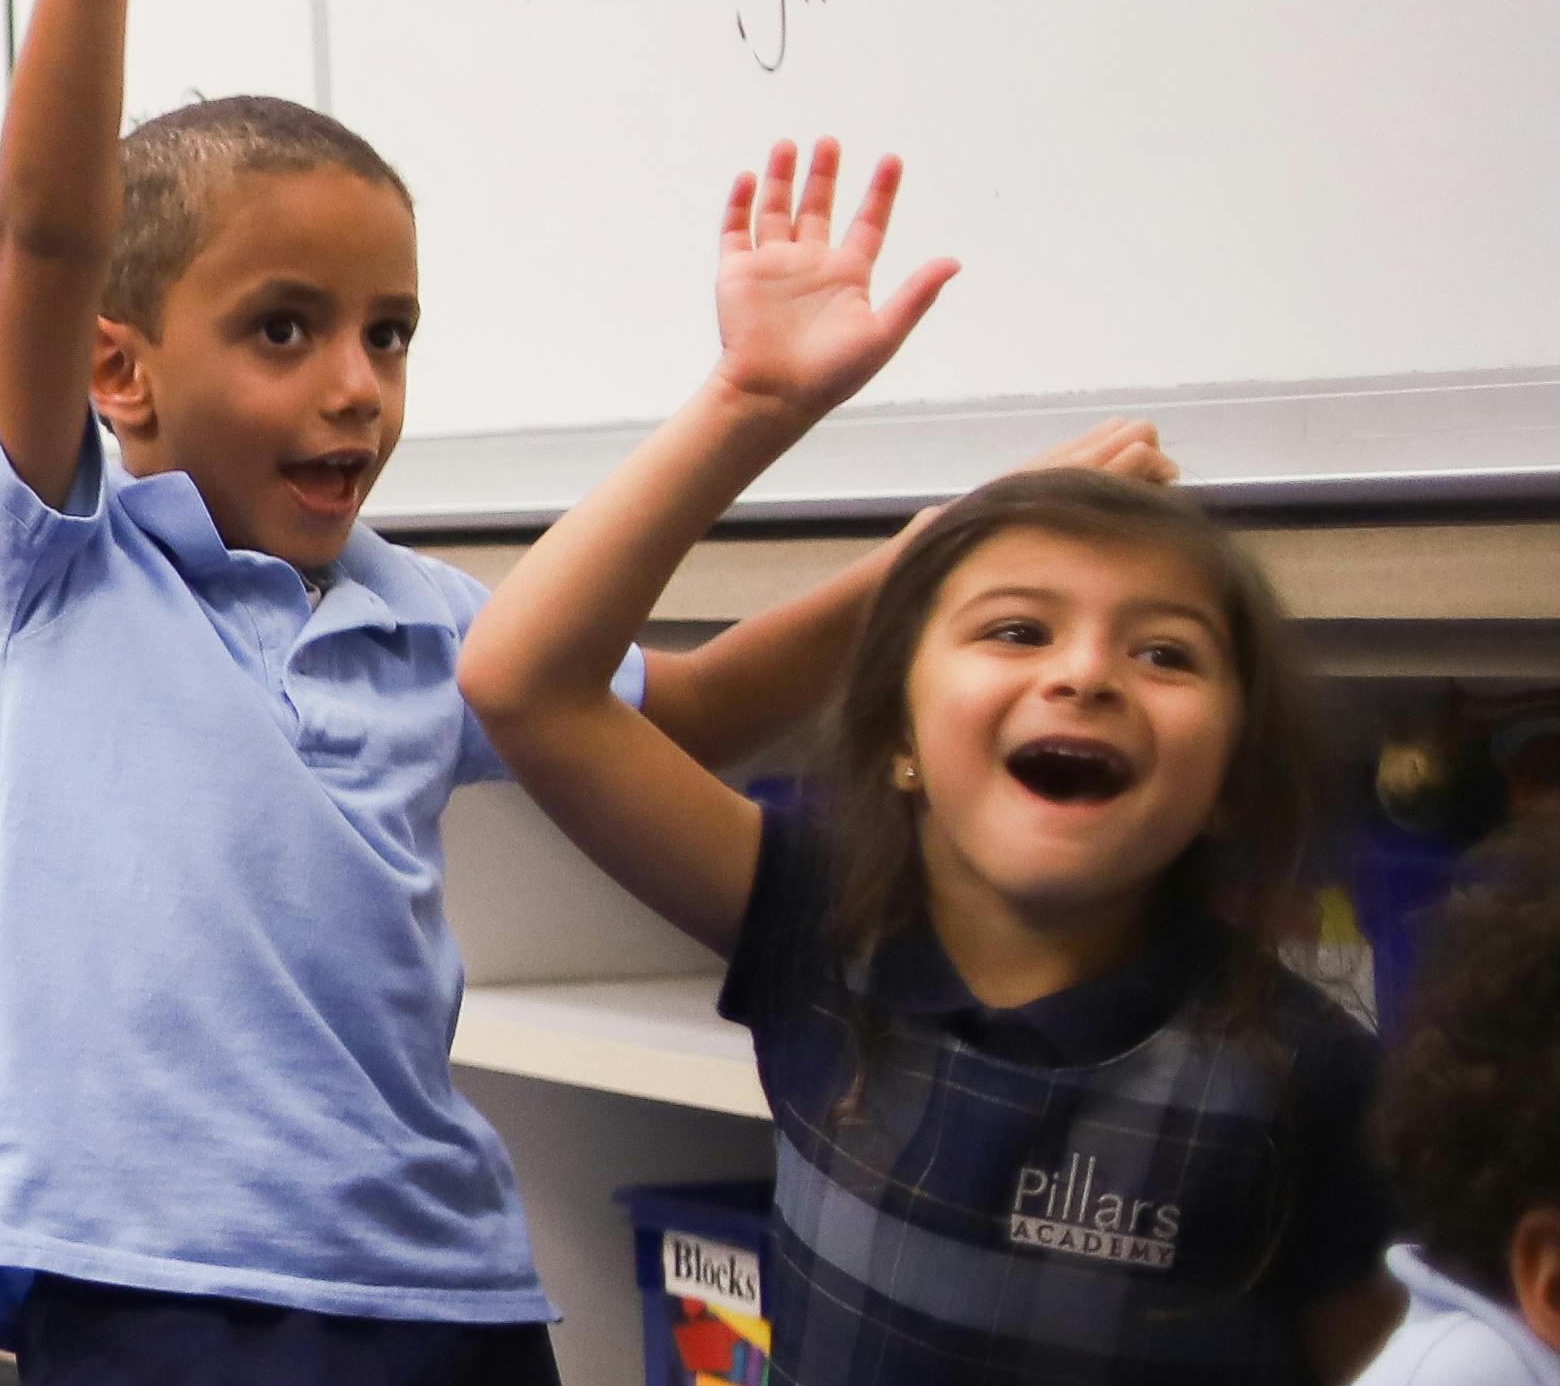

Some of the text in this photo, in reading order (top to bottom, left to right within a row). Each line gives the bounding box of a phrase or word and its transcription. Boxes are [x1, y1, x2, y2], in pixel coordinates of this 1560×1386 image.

[1012, 1153, 1182, 1239] Pillars
[670, 1236, 759, 1306] Blocks
[1011, 1217, 1176, 1268] ACADEMY
